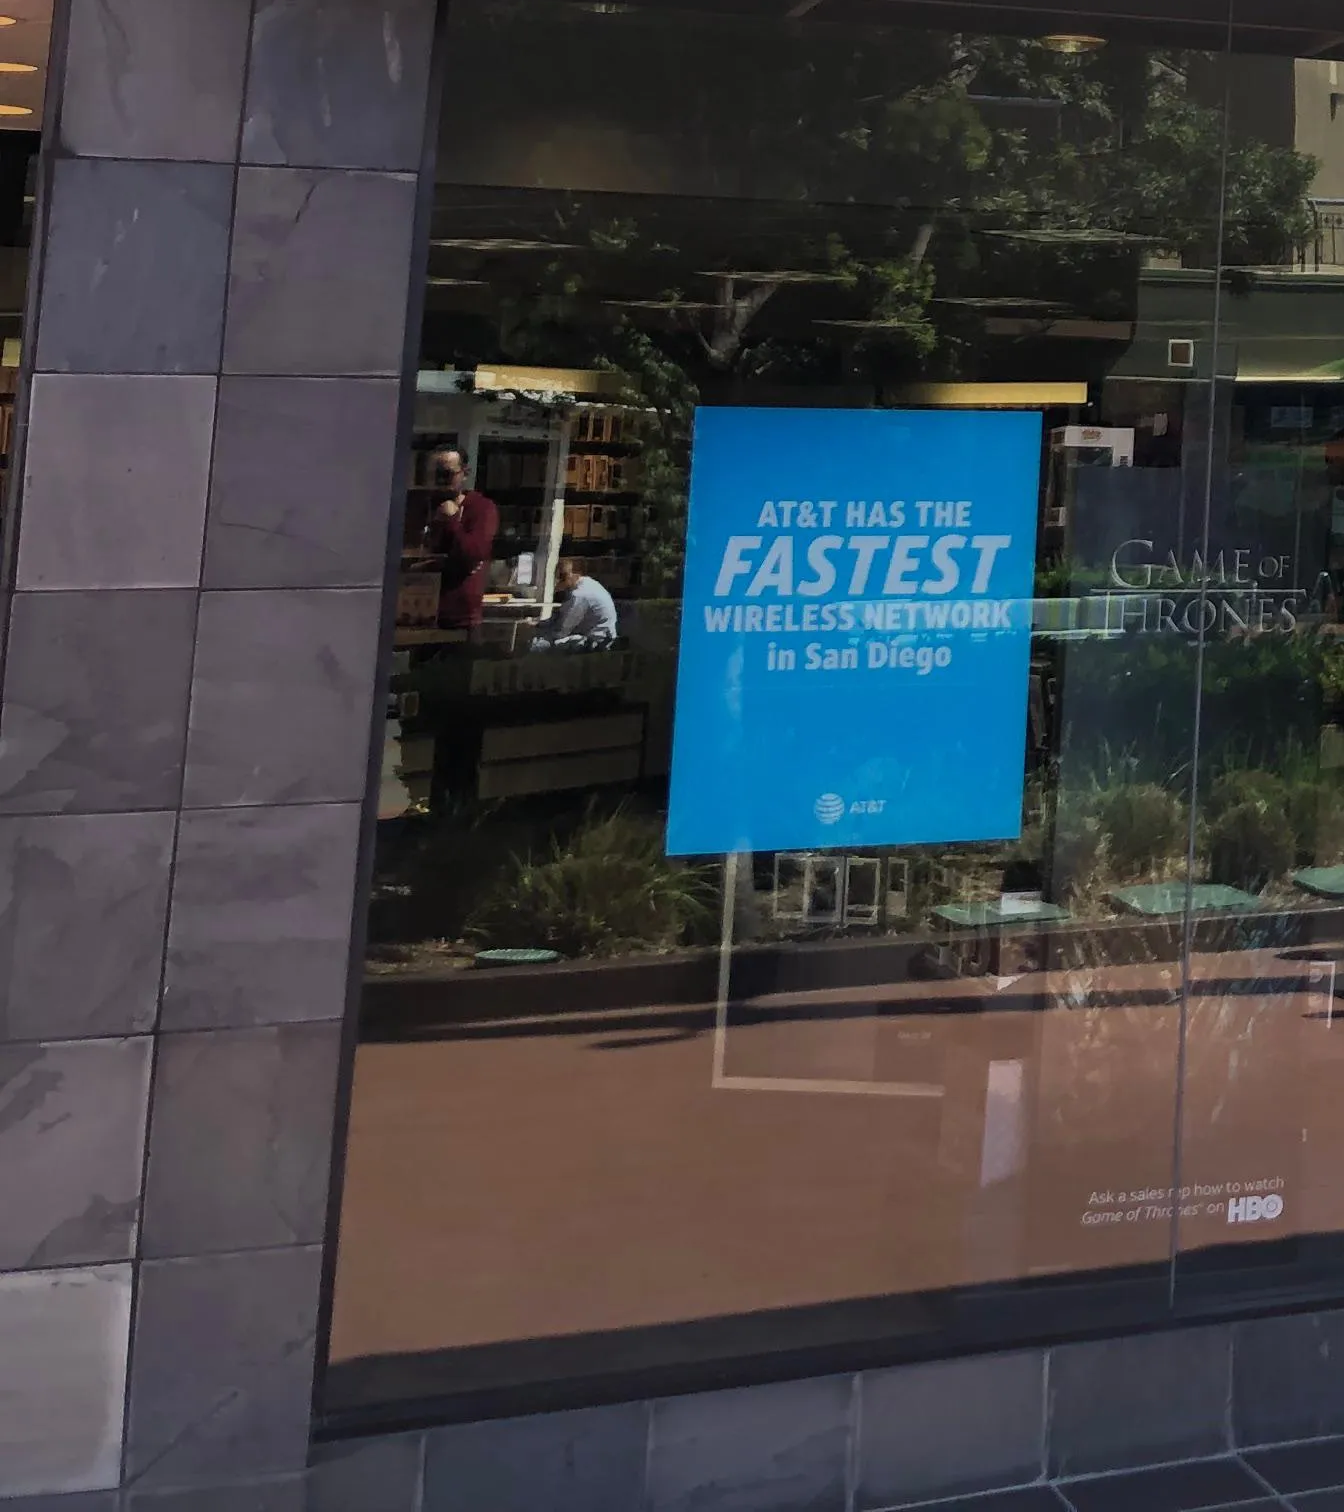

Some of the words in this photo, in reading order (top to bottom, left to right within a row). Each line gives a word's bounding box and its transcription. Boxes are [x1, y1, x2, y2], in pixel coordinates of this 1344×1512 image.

[757, 501, 837, 528] AT&T
[845, 500, 905, 528] HAS
[915, 500, 972, 528] THE
[713, 535, 1011, 596] FASTEST
[1111, 539, 1250, 588] GAME
[1258, 555, 1291, 578] OF
[704, 603, 853, 633] WIRELESS
[864, 600, 1011, 630] NETWORK
[1091, 589, 1306, 638] THRONES
[768, 642, 795, 671] in
[804, 643, 858, 671] San
[868, 642, 952, 675] Diego
[849, 799, 886, 815] AT&T
[1088, 1190, 1114, 1205] Ask
[1119, 1191, 1126, 1202] a
[1130, 1187, 1164, 1202] sales
[1168, 1186, 1191, 1200] rp
[1194, 1180, 1223, 1196] how
[1226, 1182, 1241, 1193] to
[1244, 1176, 1285, 1192] watch
[1082, 1210, 1123, 1224] Game
[1126, 1206, 1142, 1222] of
[1206, 1202, 1225, 1214] on
[1227, 1194, 1283, 1222] HBO
